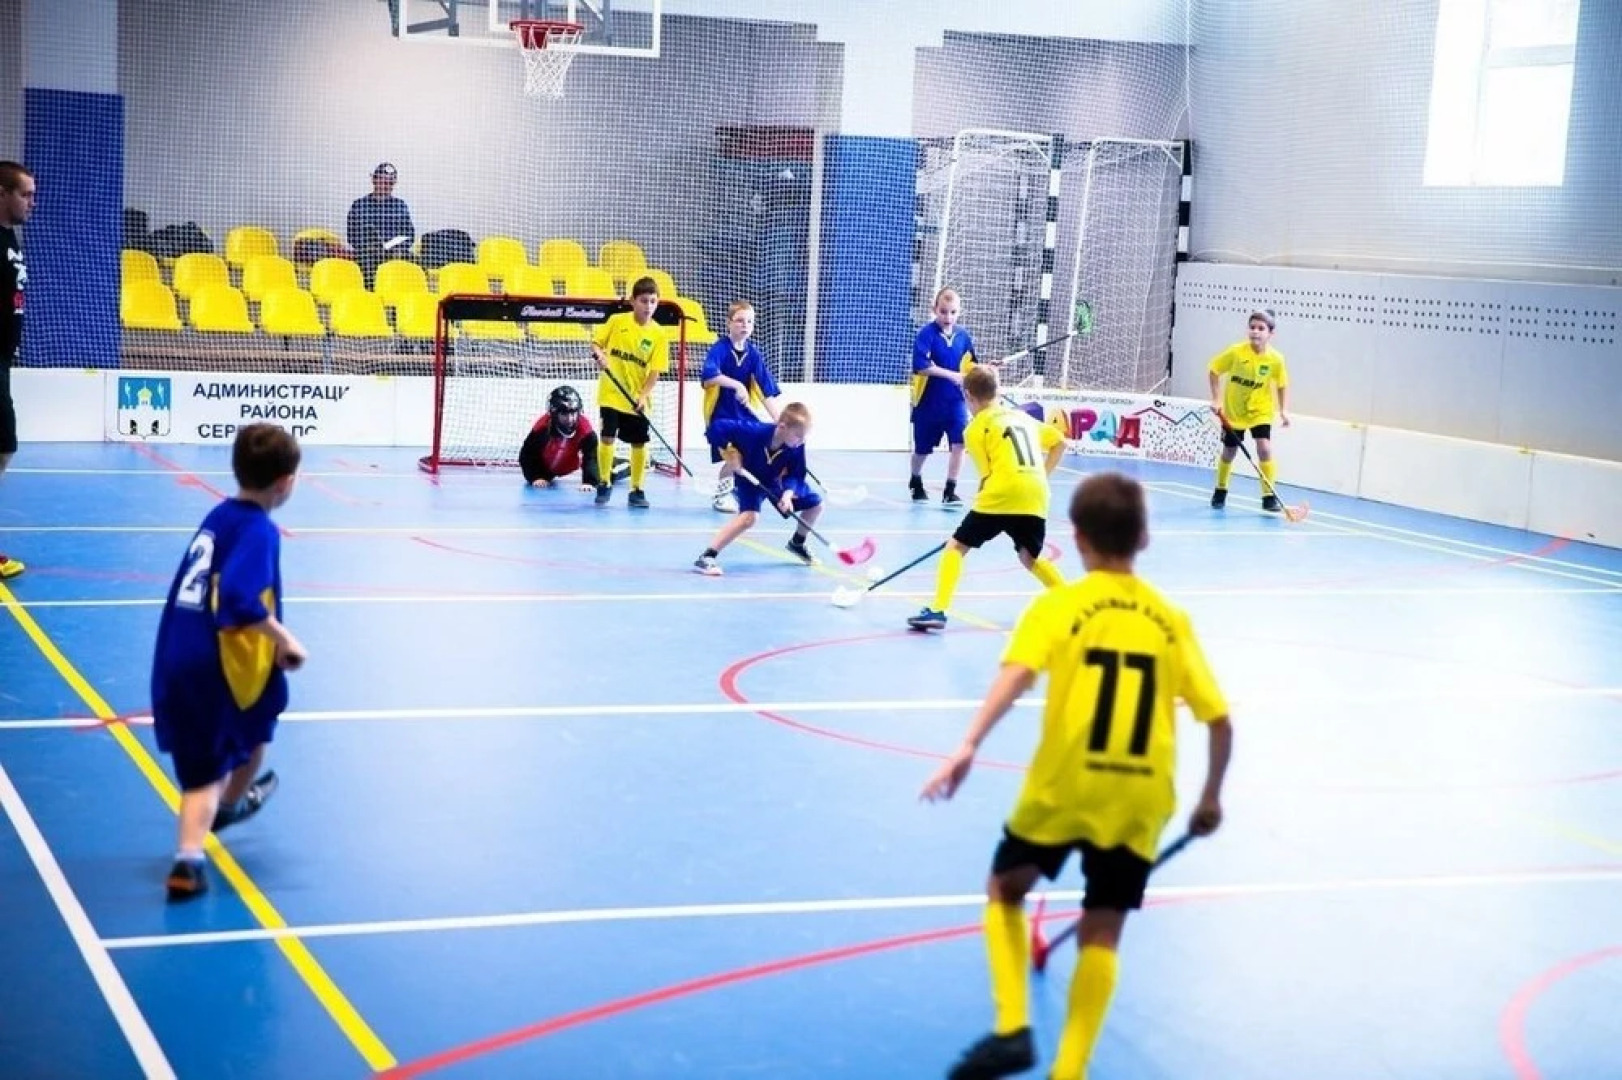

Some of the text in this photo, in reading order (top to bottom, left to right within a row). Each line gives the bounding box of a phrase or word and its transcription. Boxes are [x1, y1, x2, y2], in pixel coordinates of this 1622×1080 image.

[240, 402, 319, 420] РАЙОНА
[175, 530, 215, 610] 2
[1084, 647, 1157, 756] 11
